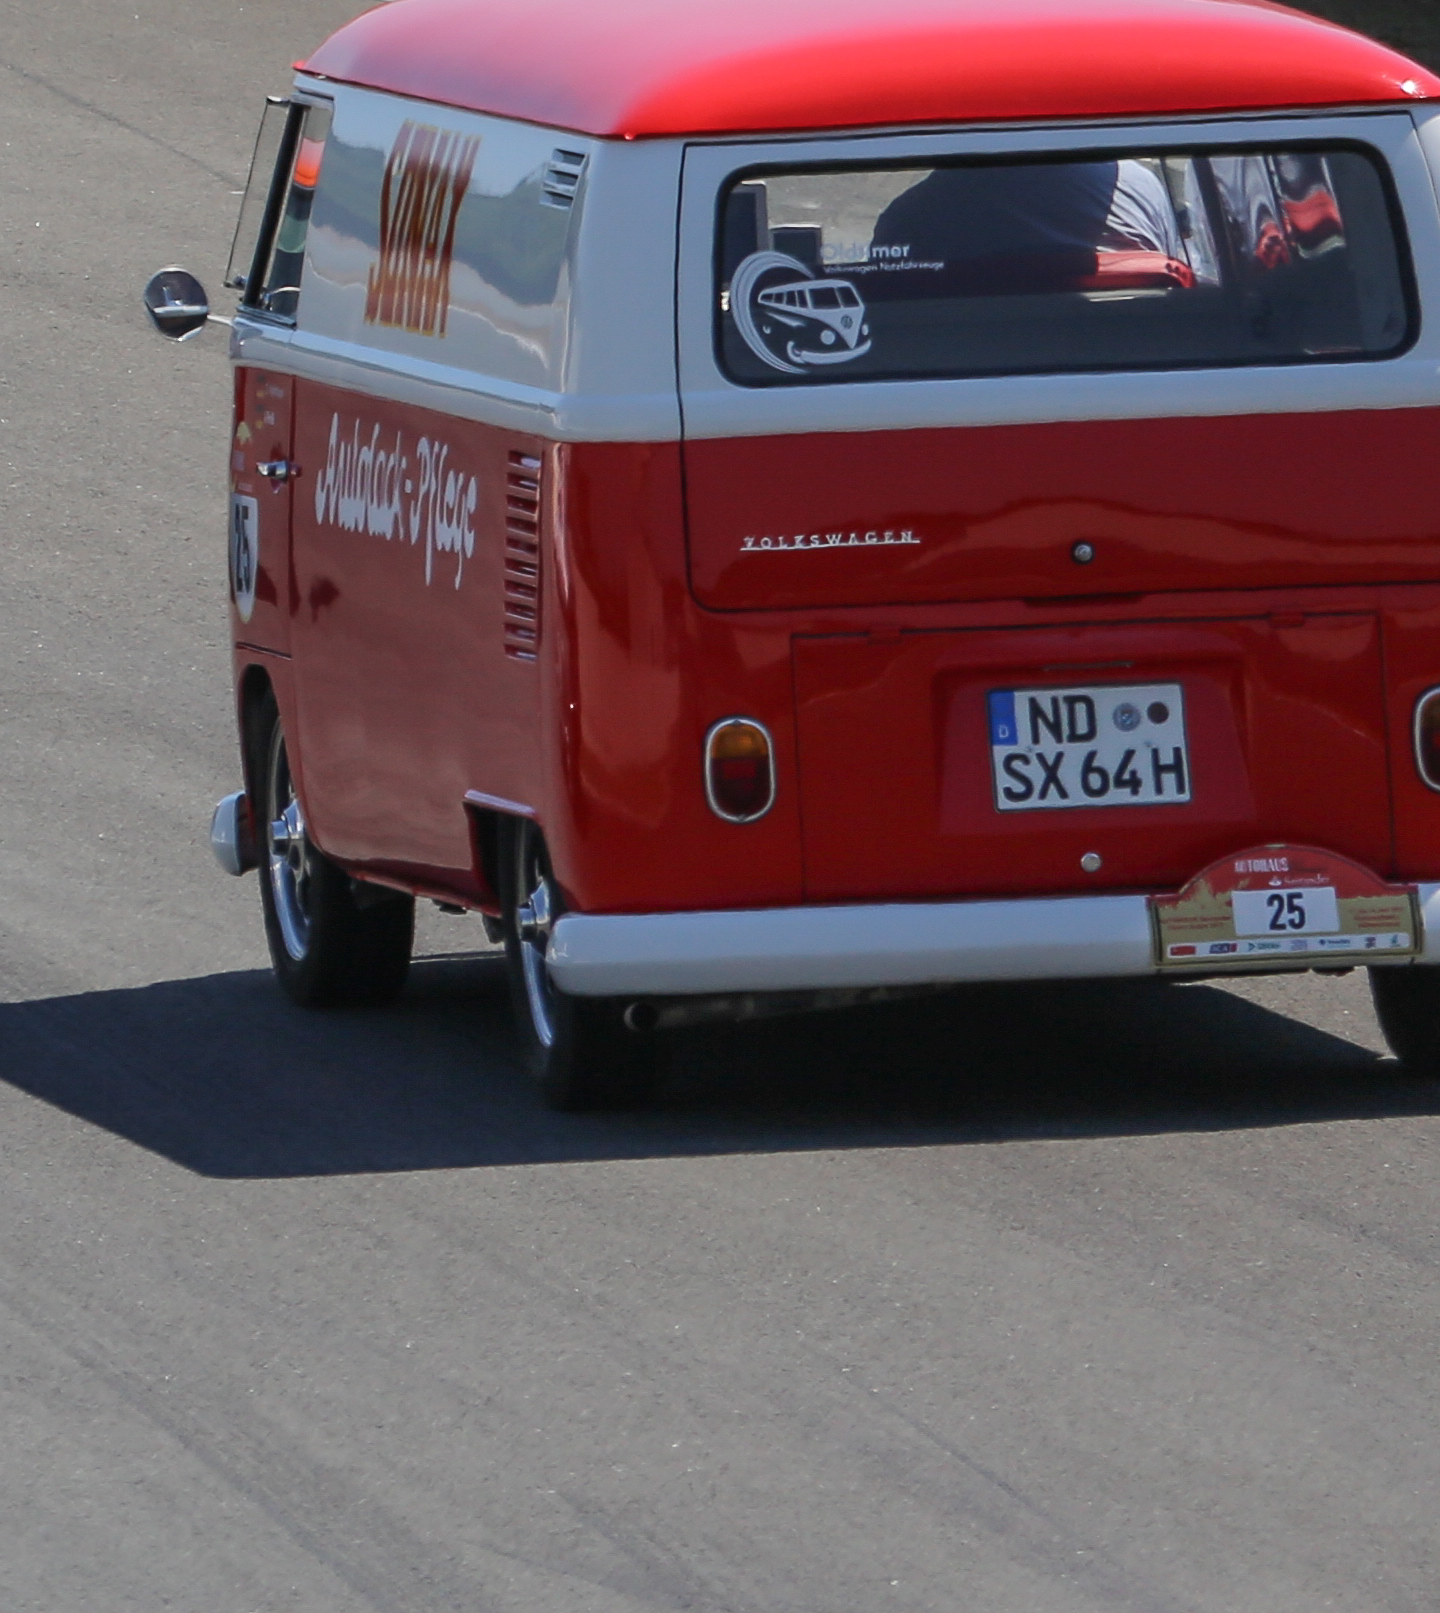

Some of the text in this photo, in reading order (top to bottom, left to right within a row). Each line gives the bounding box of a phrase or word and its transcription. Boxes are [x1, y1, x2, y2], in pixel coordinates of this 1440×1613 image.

[743, 531, 914, 549] VOLKSWAGEN
[1028, 694, 1097, 746] ND
[1002, 751, 1069, 803] SX
[1266, 892, 1306, 931] 25
